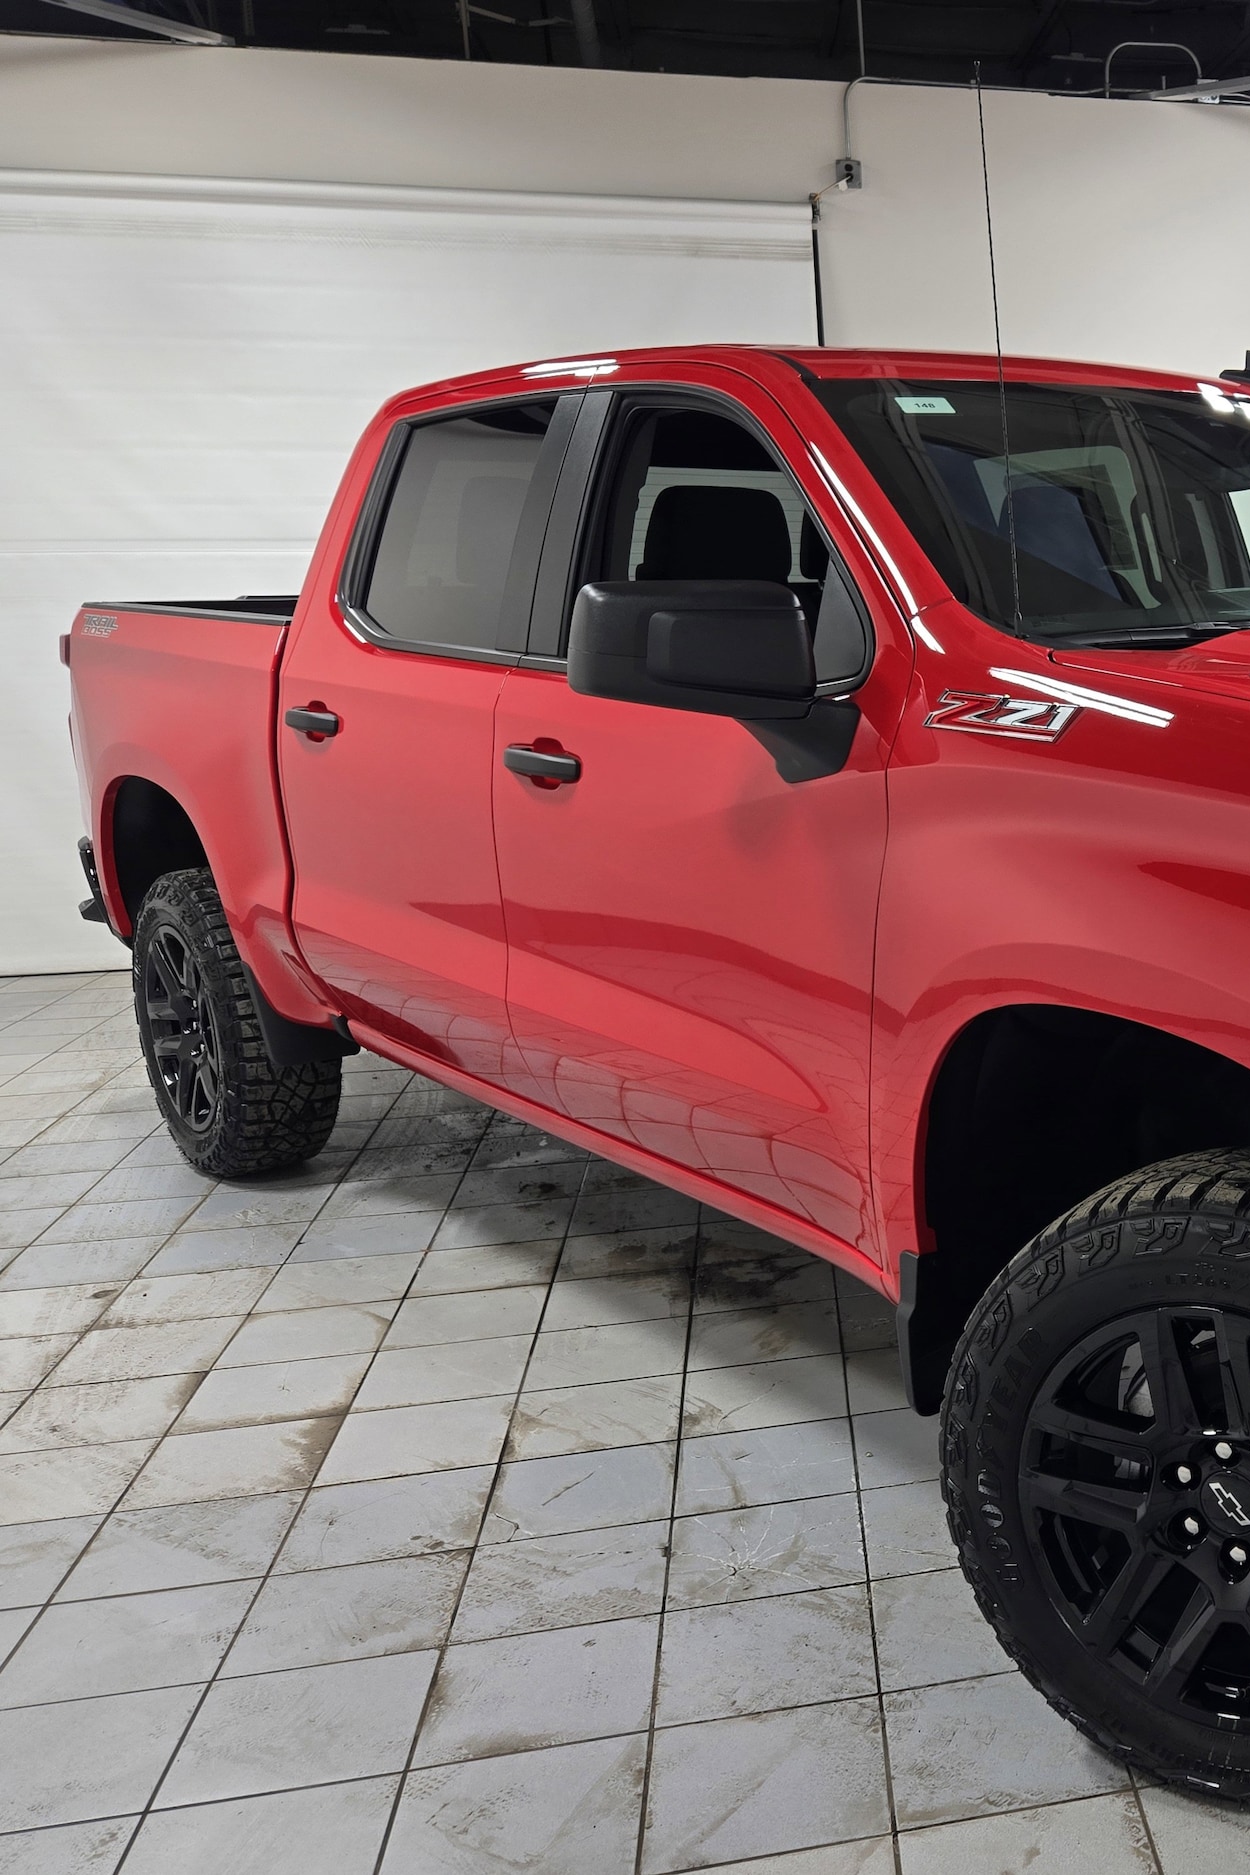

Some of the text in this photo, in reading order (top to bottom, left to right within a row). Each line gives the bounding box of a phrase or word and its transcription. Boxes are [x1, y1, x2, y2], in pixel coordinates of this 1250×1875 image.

[81, 626, 112, 638] BOSS
[83, 613, 119, 630] TRAIL
[924, 688, 1084, 743] Z71
[976, 1326, 1042, 1594] GOODYEAR
